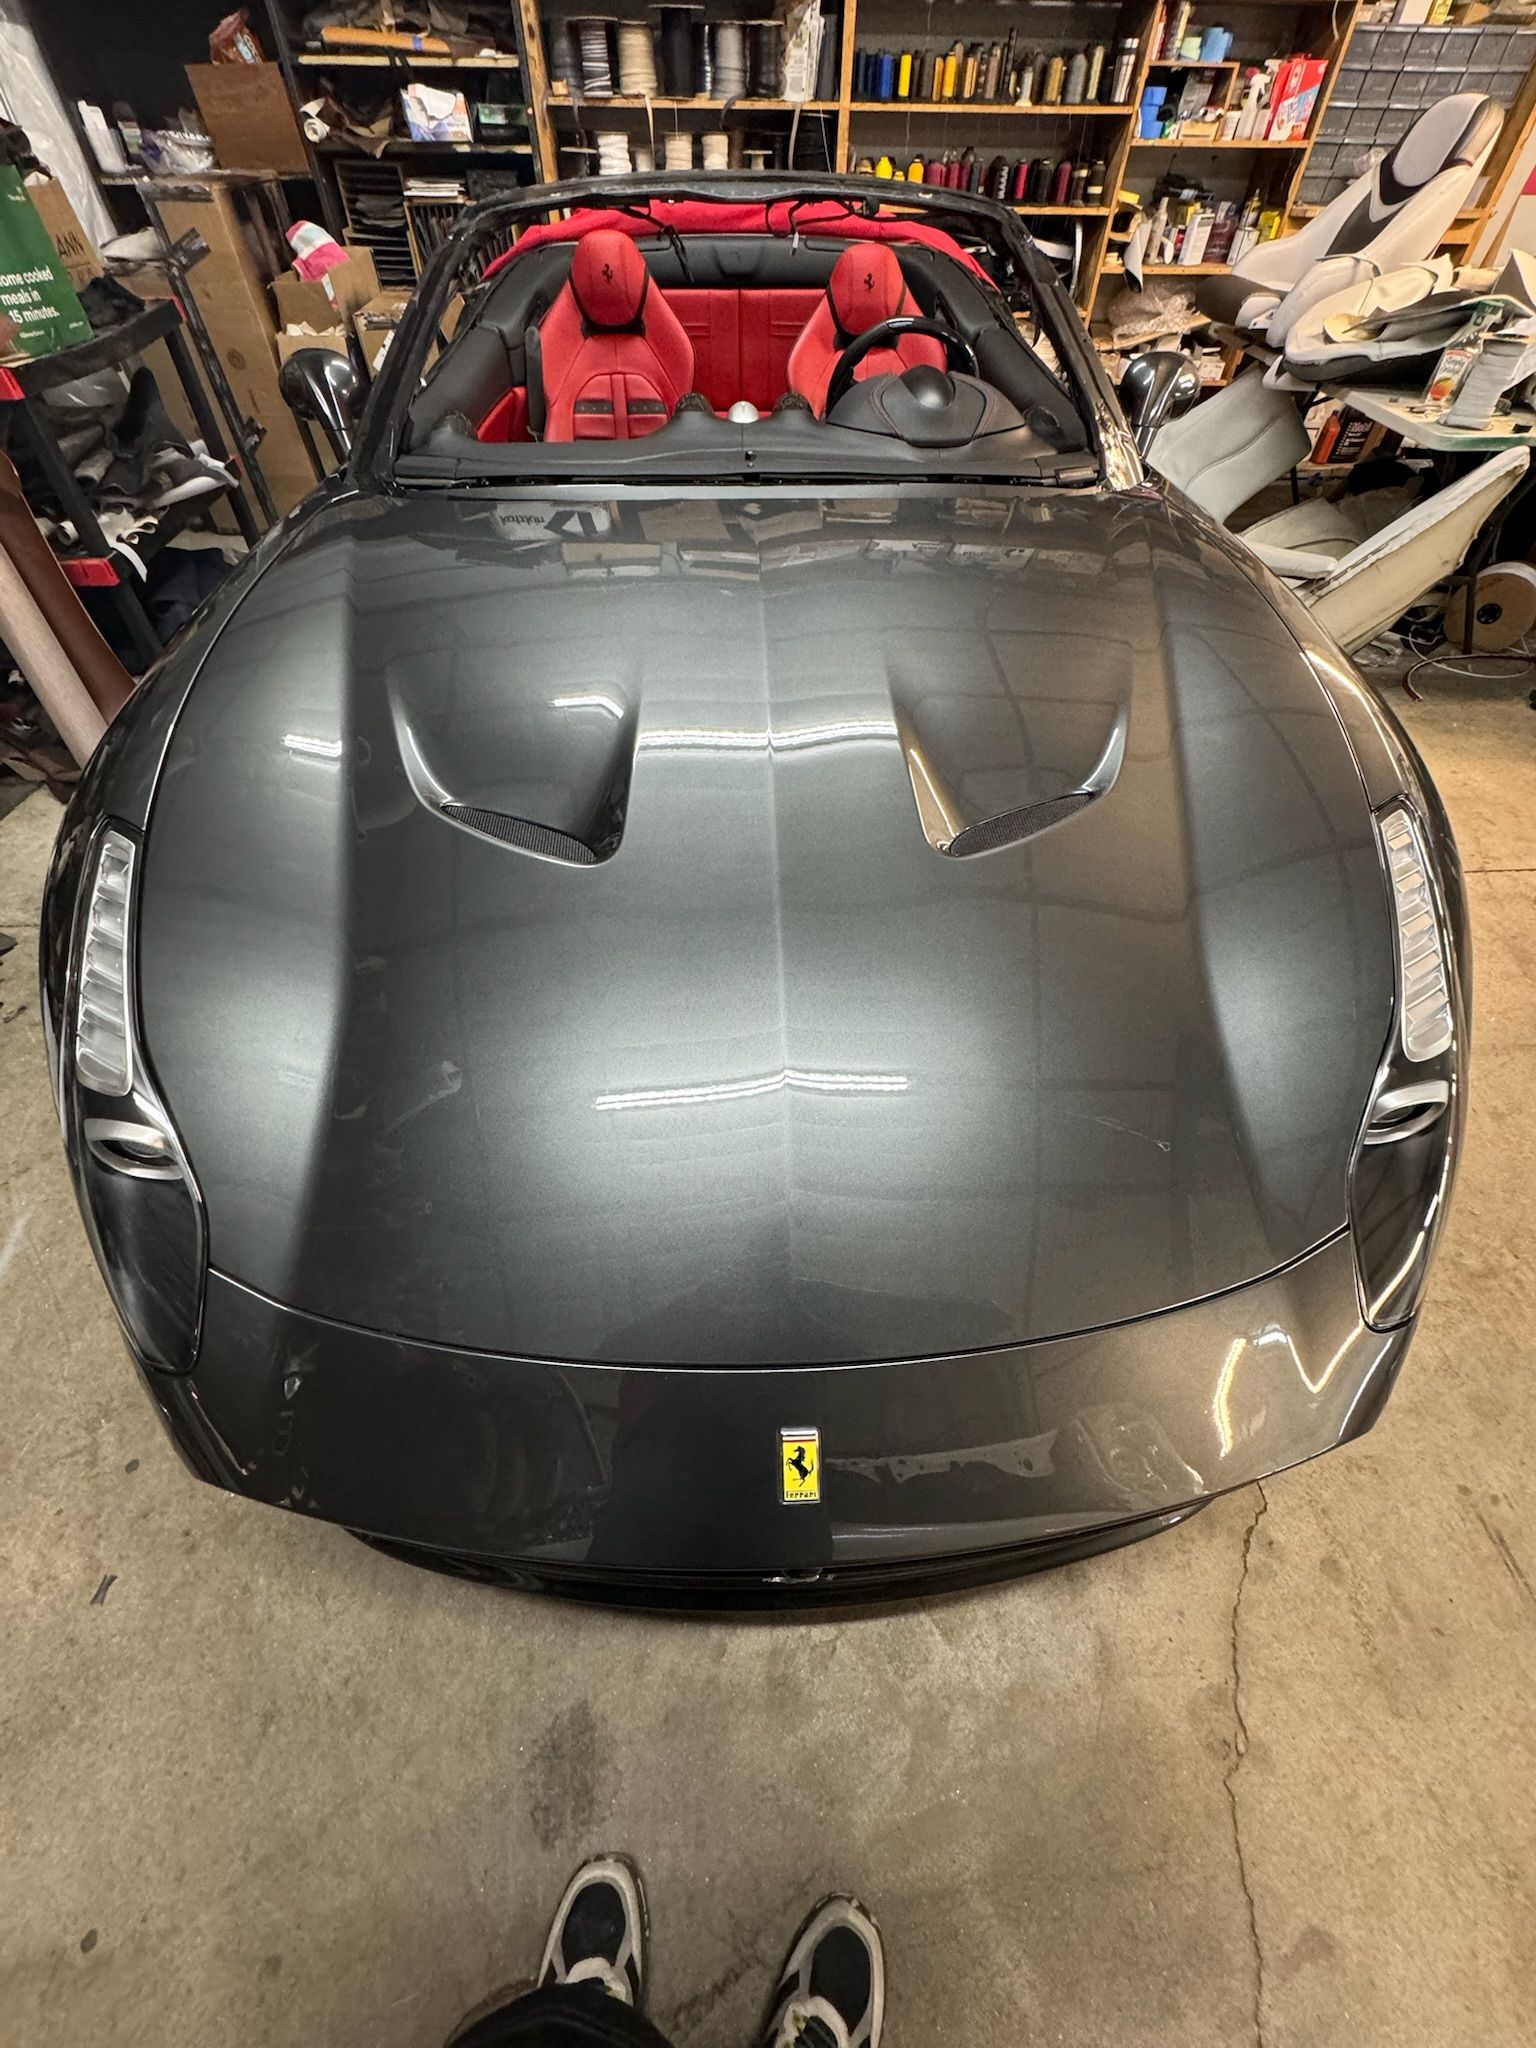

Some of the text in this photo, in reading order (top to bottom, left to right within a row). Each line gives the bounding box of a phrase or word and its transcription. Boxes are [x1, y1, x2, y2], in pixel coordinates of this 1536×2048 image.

[22, 265, 54, 284] cooked
[0, 287, 42, 306] meals in
[9, 305, 60, 323] 15 minutes.
